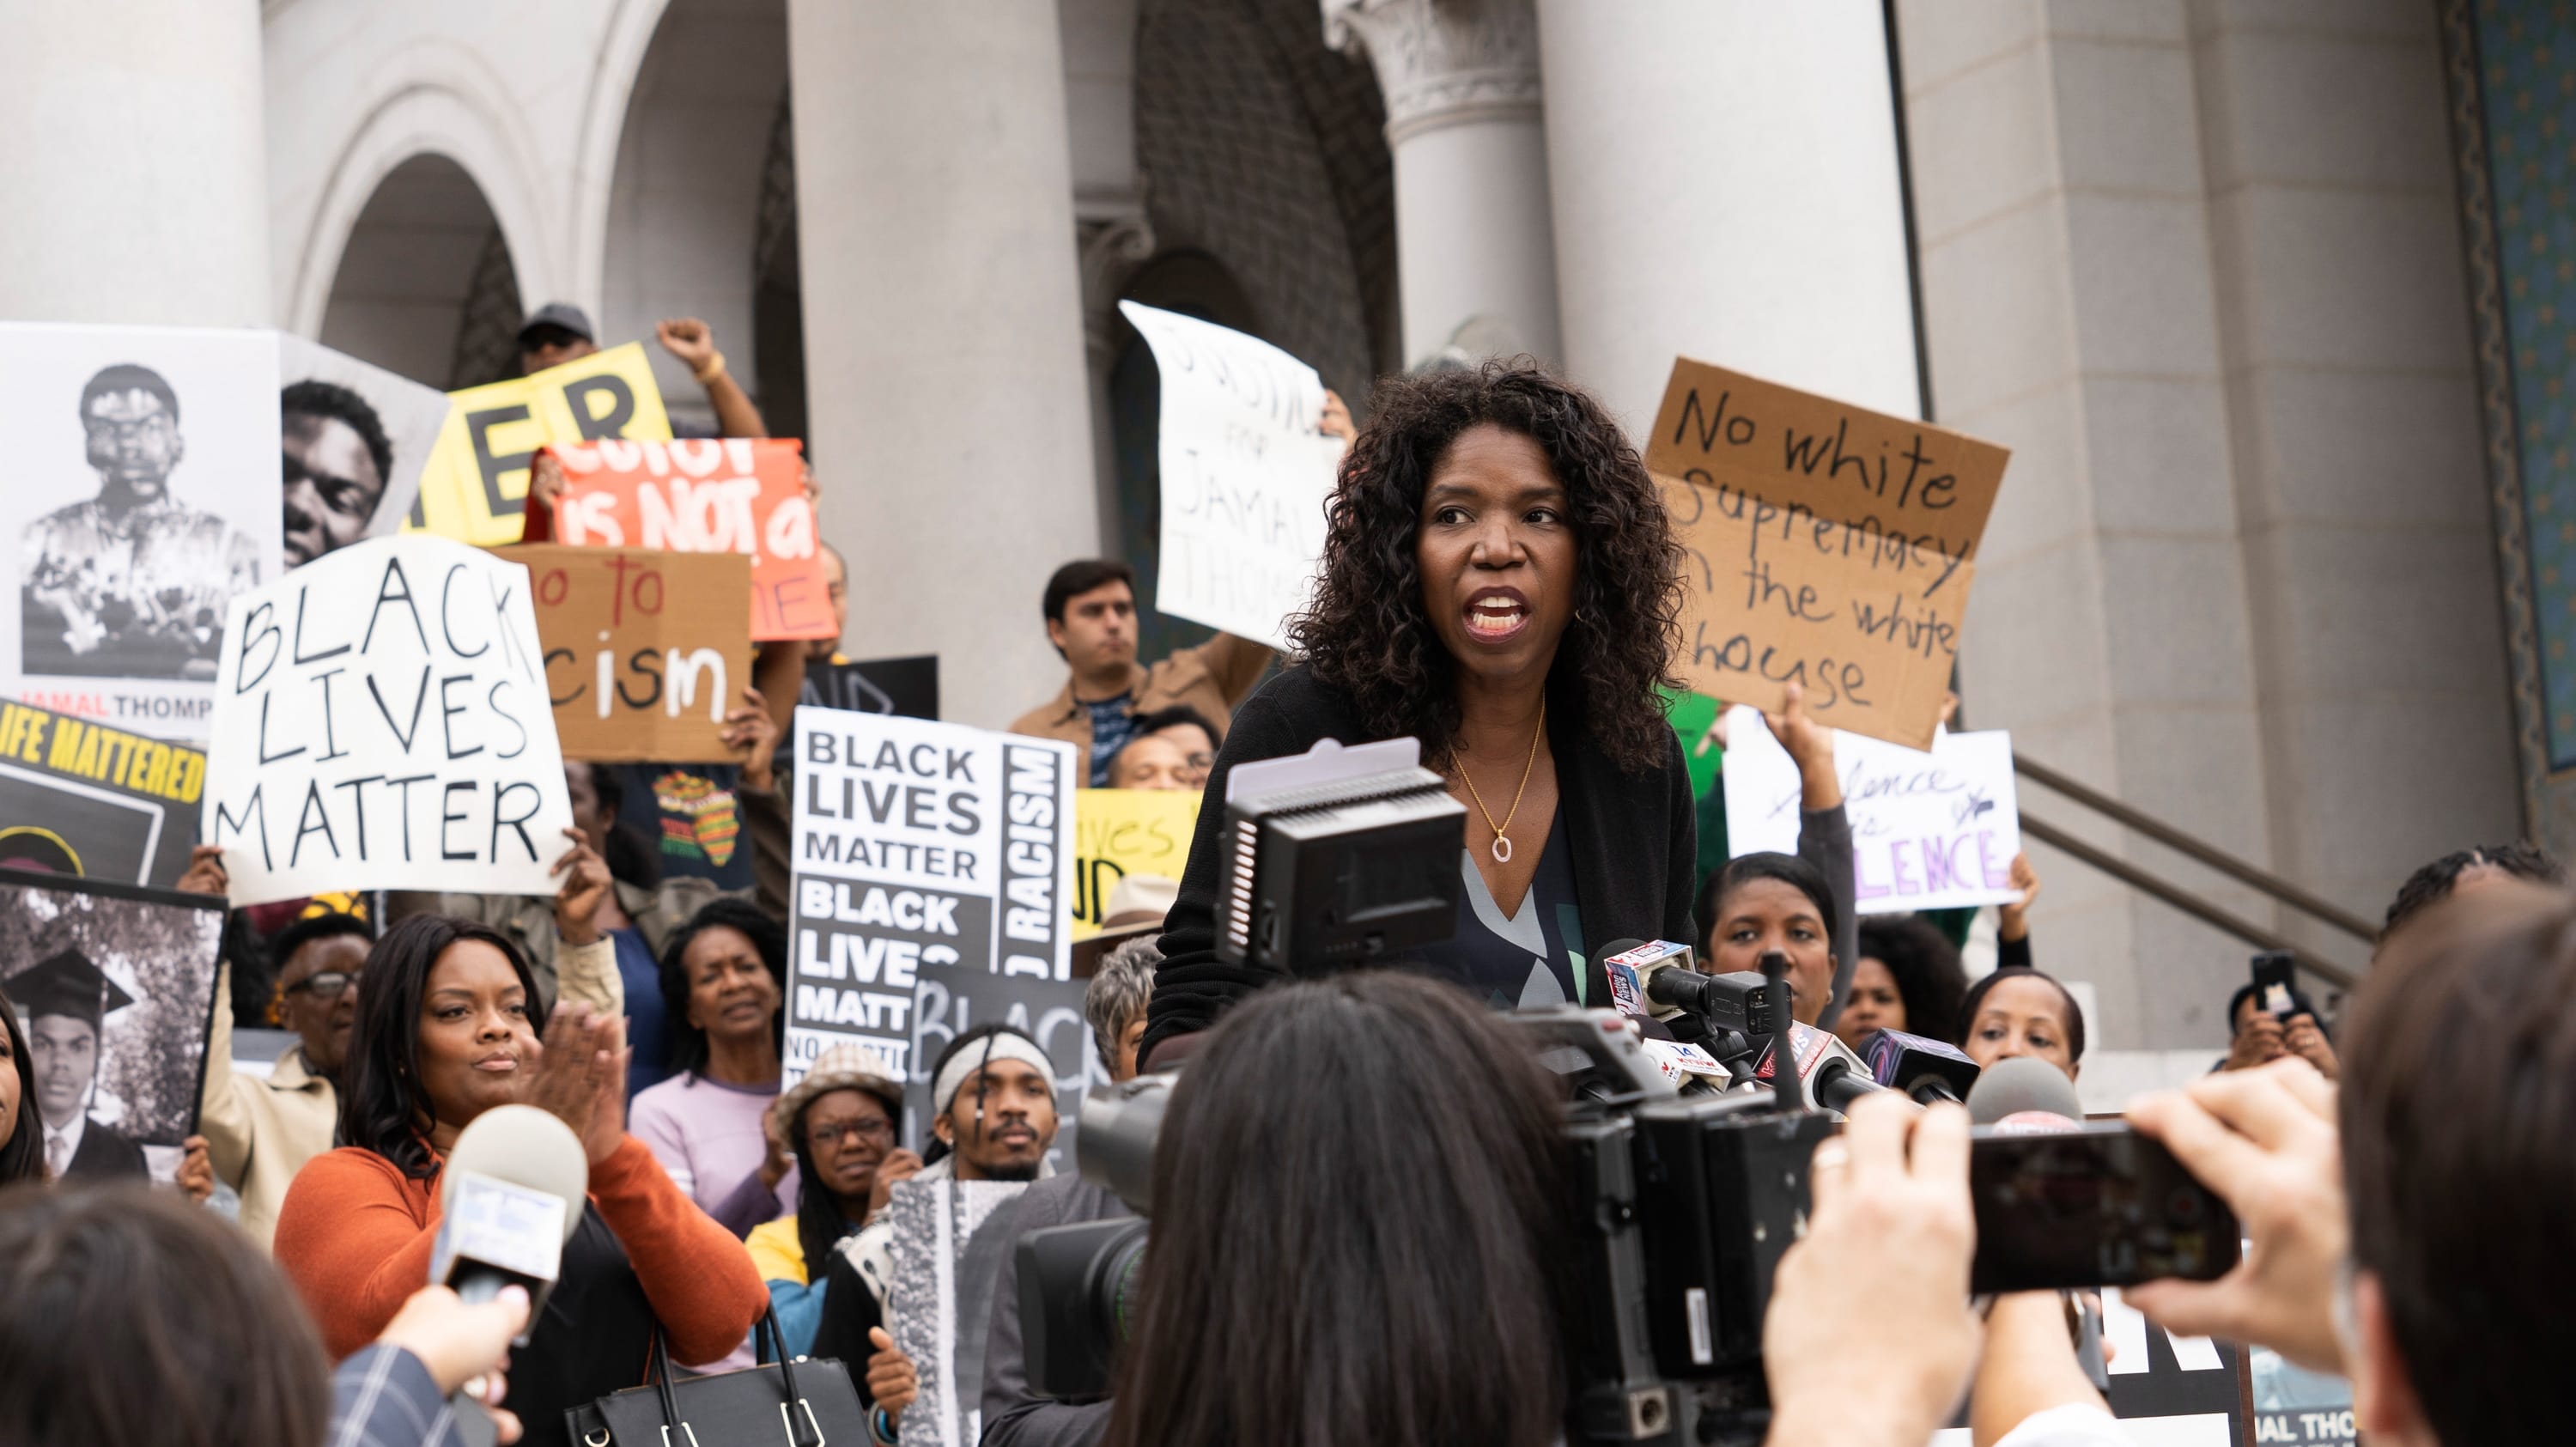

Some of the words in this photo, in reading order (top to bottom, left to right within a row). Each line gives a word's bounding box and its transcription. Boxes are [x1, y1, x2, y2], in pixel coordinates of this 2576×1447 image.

[410, 374, 635, 528] ER
[1674, 388, 1756, 453] No
[1785, 417, 1956, 508] white
[637, 477, 762, 568] NOT
[765, 495, 816, 560] a
[236, 556, 535, 695] BLACK
[1742, 563, 1836, 622] the
[1851, 593, 1955, 658] white
[1692, 619, 1872, 710] house
[47, 715, 206, 805] MATTERED
[259, 665, 527, 764] LIVES
[807, 731, 977, 783] BLACK
[215, 775, 540, 872] MATTER
[807, 774, 981, 836] LIVES
[1005, 745, 1057, 943] RACISM
[805, 831, 977, 880] MATTER
[799, 879, 960, 936] BLACK
[795, 984, 913, 1031] MATT
